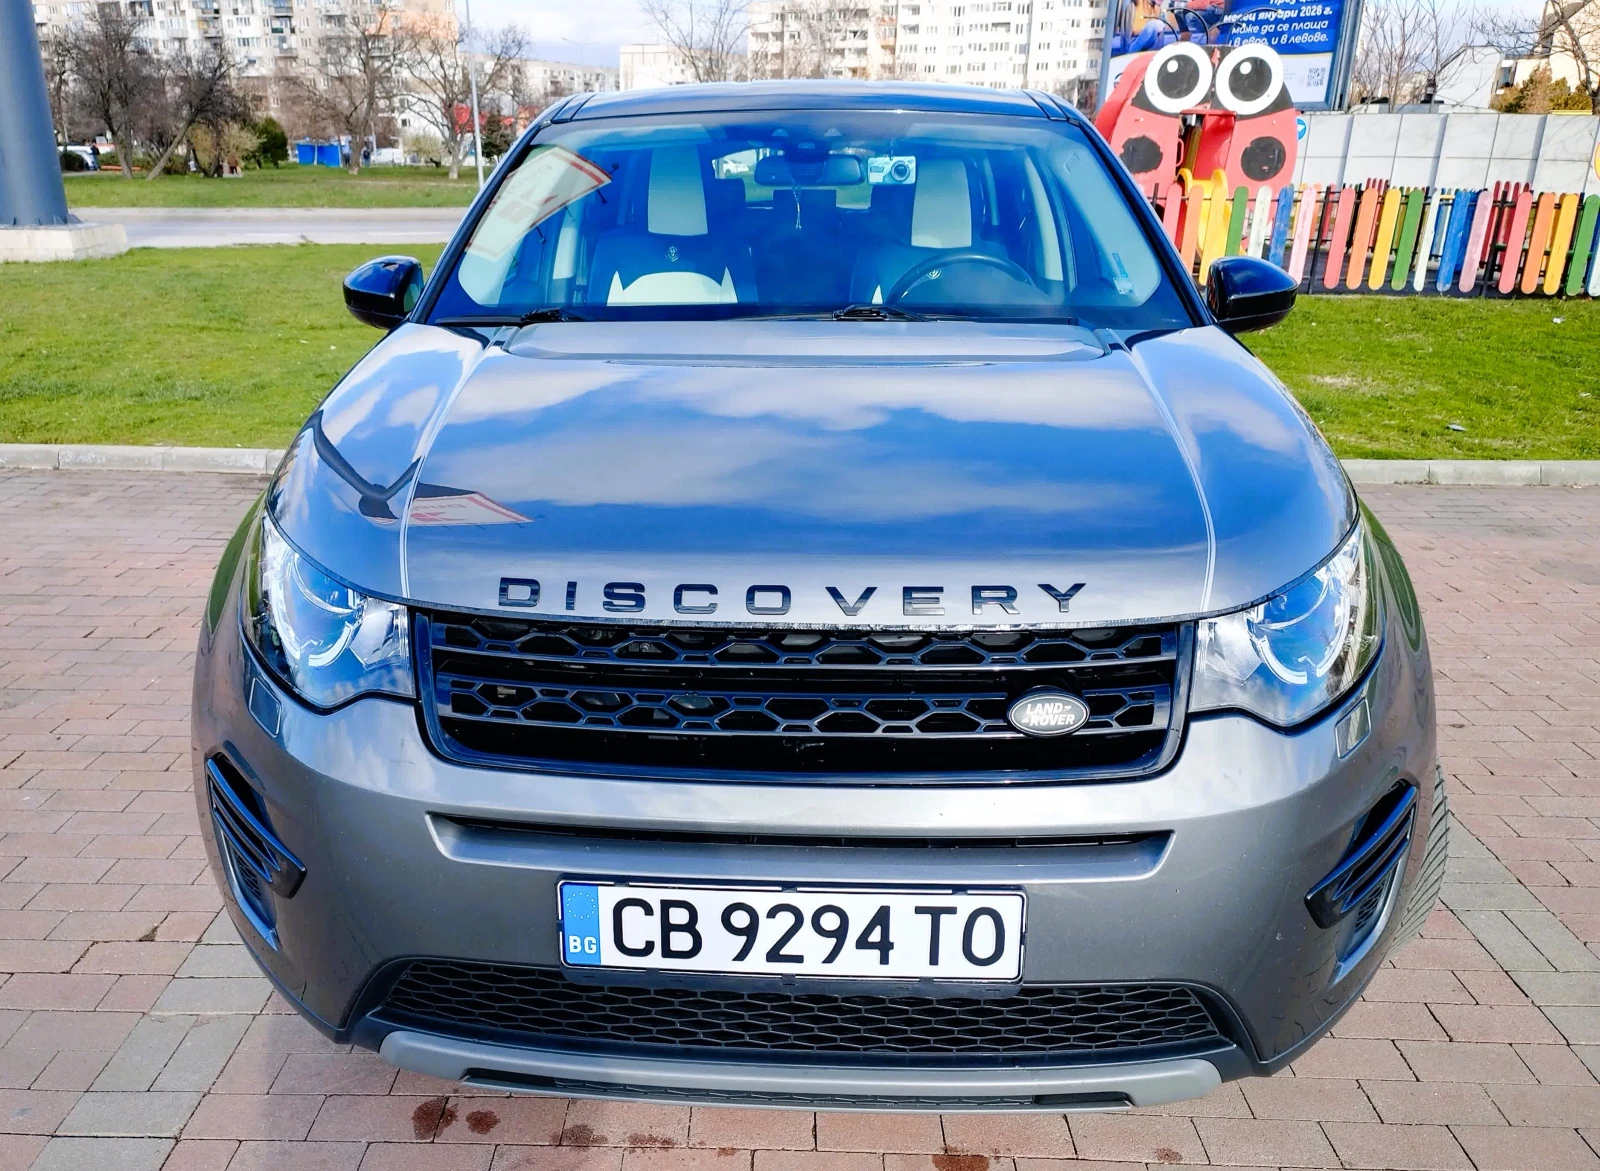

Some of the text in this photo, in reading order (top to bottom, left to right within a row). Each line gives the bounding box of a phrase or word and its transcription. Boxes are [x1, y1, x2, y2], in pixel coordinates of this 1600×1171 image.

[1257, 9, 1298, 21] януари
[1300, 5, 1323, 17] 2026
[1231, 20, 1329, 34] може да се плаща
[1271, 37, 1278, 45] и
[1280, 34, 1288, 44] в
[1288, 32, 1329, 44] левове.
[499, 577, 1086, 616] DISCOVERY
[612, 897, 1006, 967] CB 9294 TO
[569, 935, 597, 954] BG
